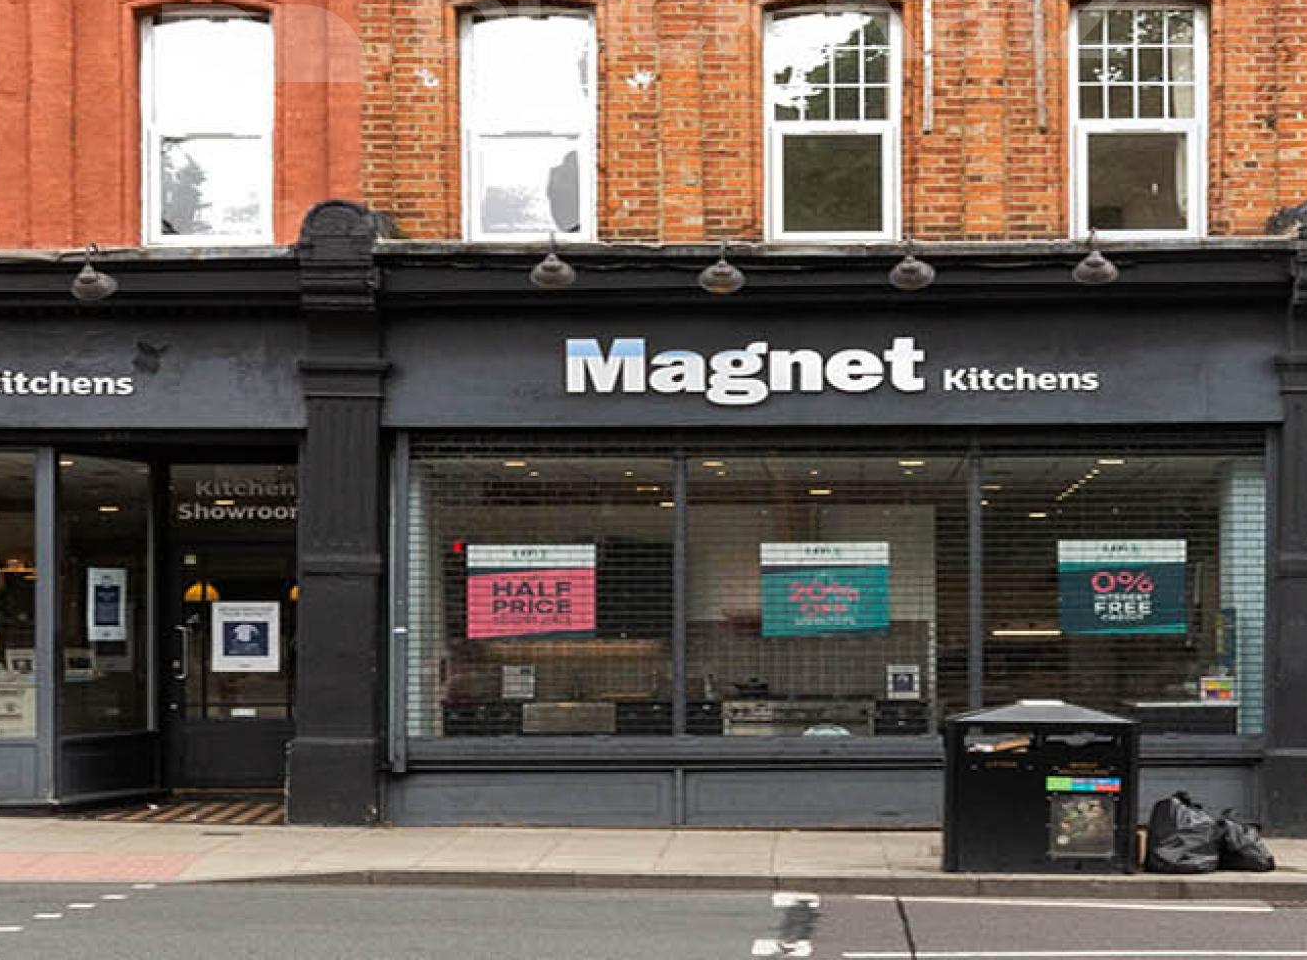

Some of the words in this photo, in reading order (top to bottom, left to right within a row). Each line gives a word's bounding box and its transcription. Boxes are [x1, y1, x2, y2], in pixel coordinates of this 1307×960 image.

[566, 337, 926, 406] Magnet
[943, 367, 1100, 392] Kitchens
[195, 480, 295, 496] Kitchen
[492, 581, 573, 597] HALF
[1090, 571, 1156, 592] 0%
[492, 599, 573, 614] PRICE
[1094, 602, 1153, 615] FREE
